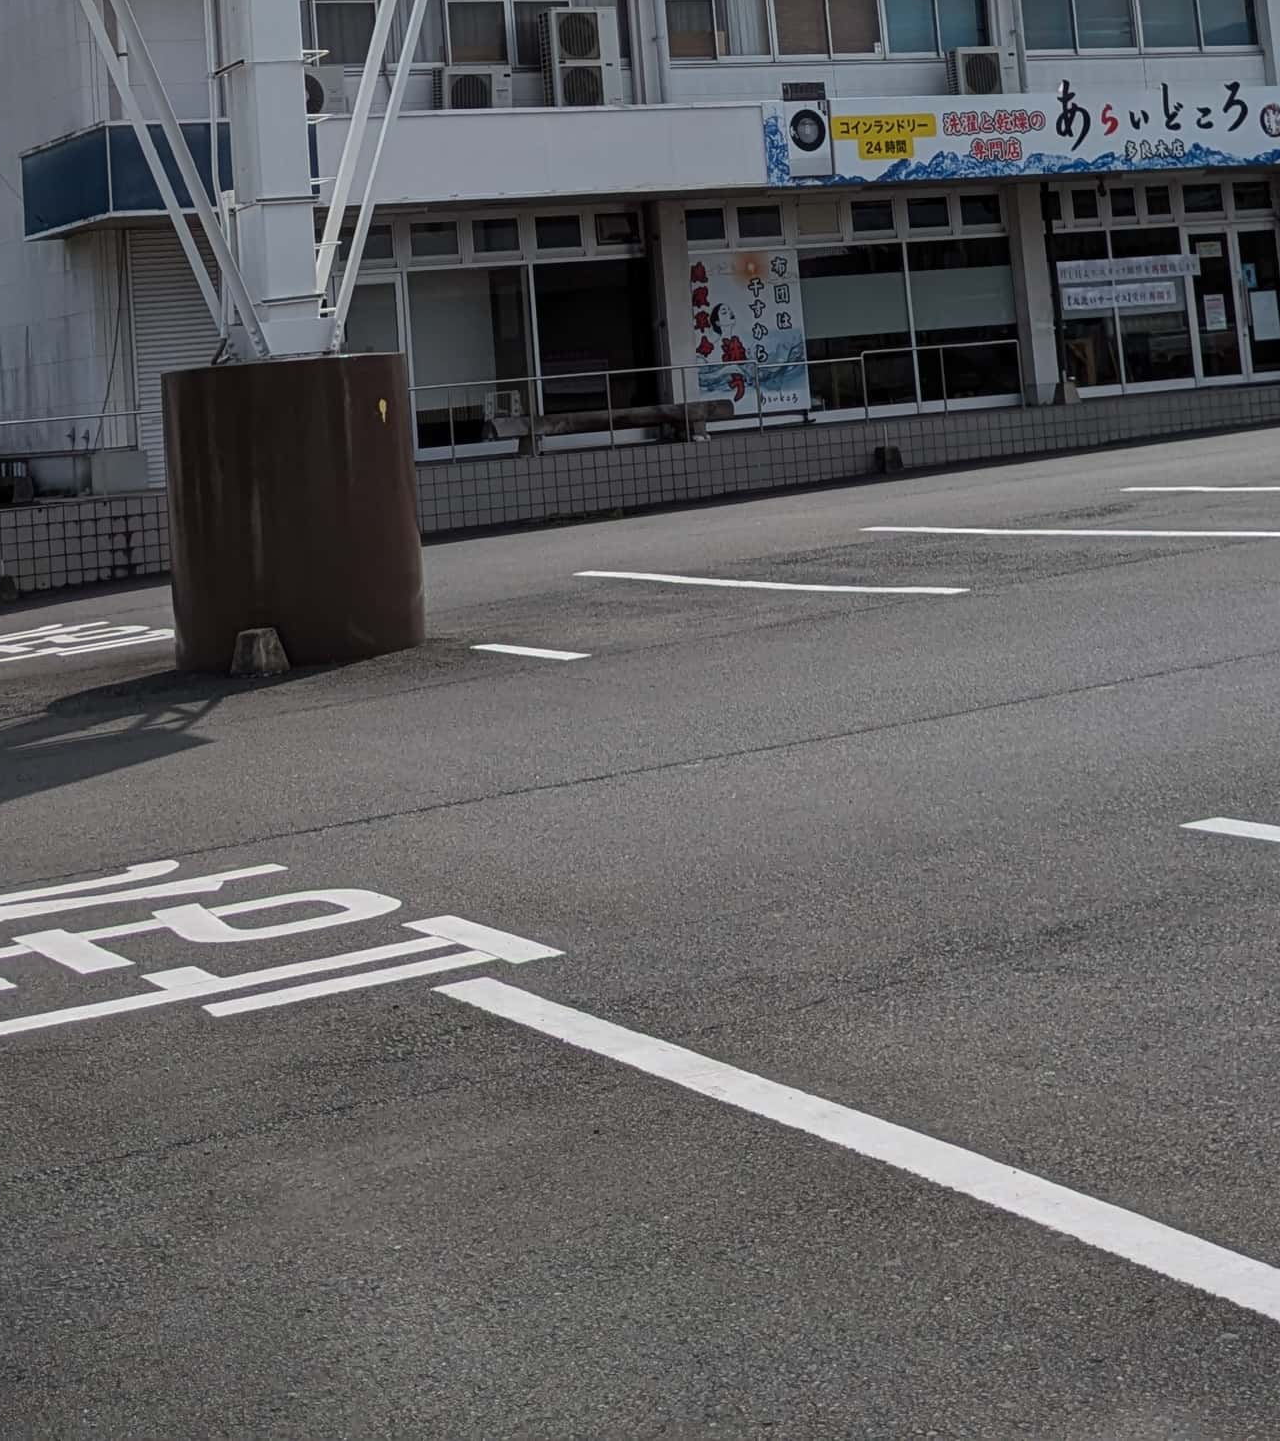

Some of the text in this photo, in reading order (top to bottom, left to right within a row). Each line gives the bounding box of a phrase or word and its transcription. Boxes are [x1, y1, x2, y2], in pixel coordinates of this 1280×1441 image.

[839, 119, 929, 135] コインランドリー
[943, 110, 1047, 137] 洗濯と乾燥の
[1055, 79, 1248, 152] あらいどころ
[865, 139, 907, 155] 24時間
[970, 137, 1022, 161] 専門店
[1125, 138, 1186, 159] 多良木店
[771, 257, 793, 330] 布団は
[748, 277, 769, 362] 干すから
